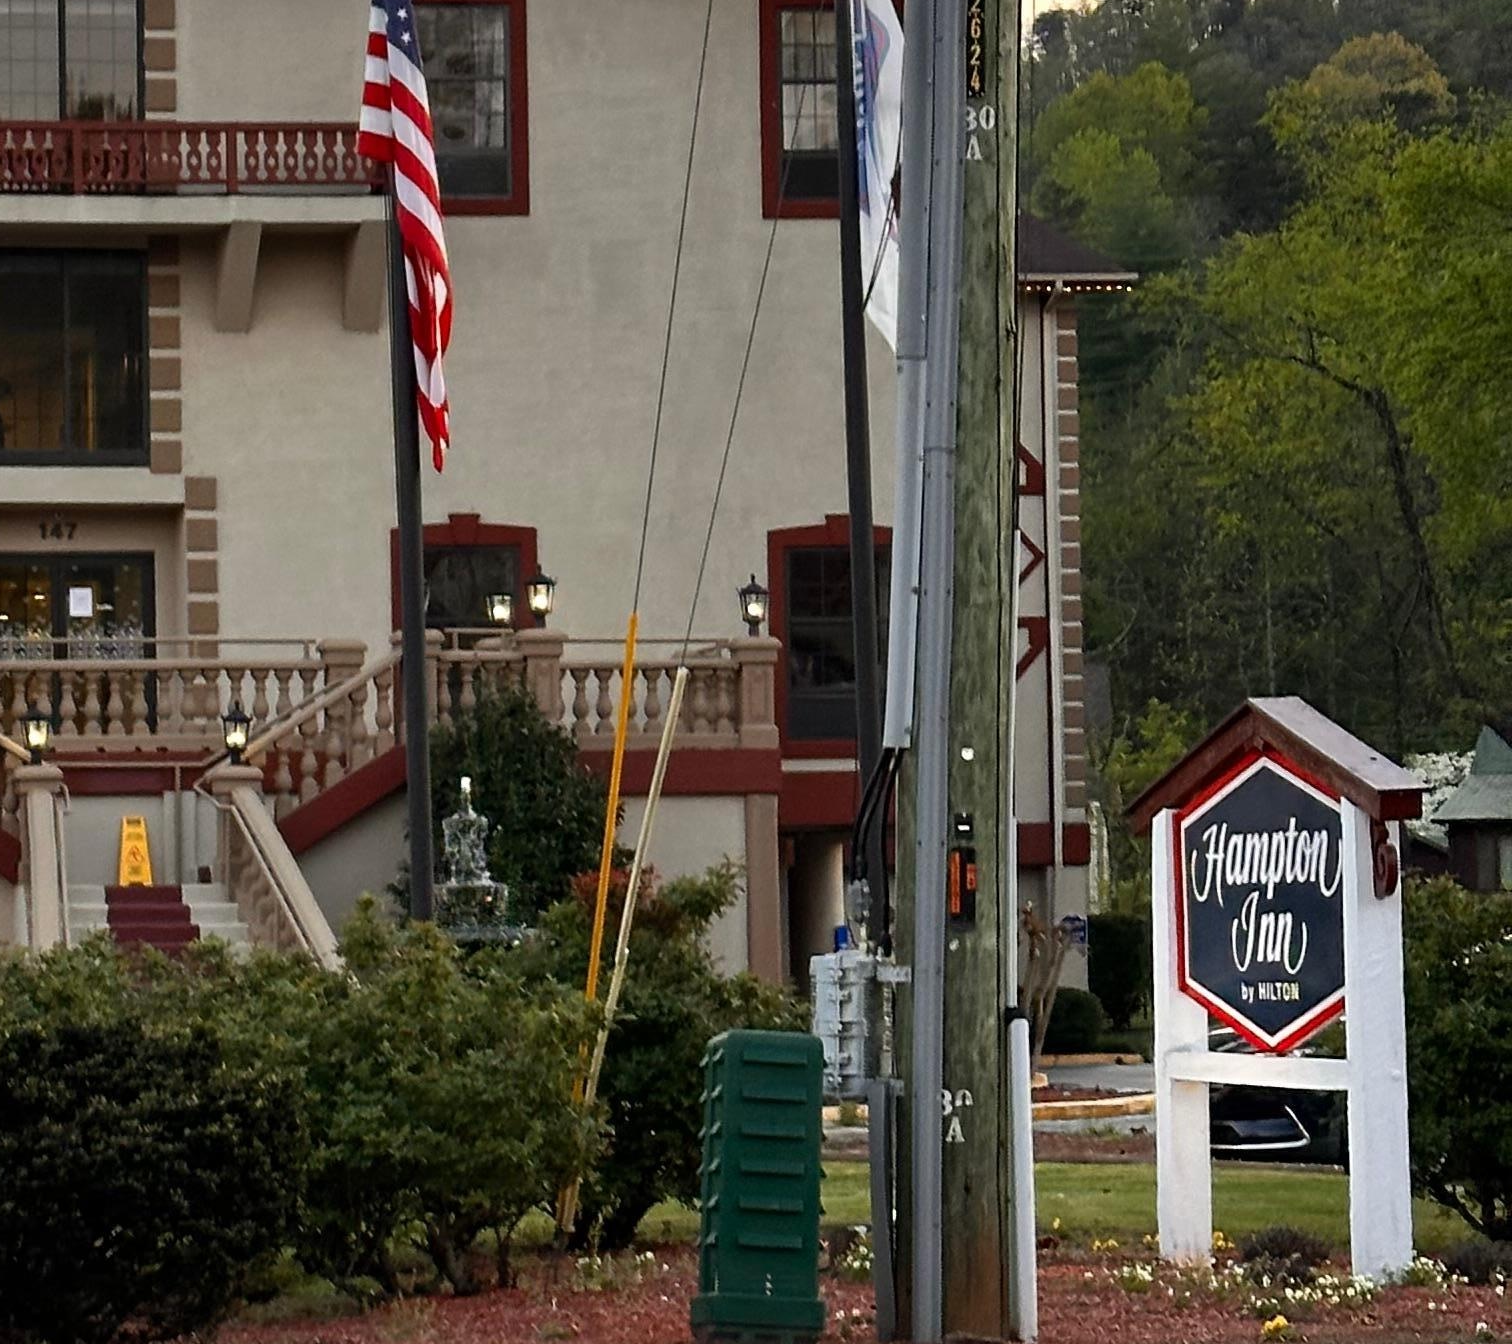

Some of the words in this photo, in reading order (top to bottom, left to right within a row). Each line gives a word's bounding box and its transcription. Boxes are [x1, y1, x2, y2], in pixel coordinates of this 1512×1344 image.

[966, 134, 983, 161] A
[39, 522, 77, 540] 147
[1191, 817, 1343, 909] Hampton
[1232, 891, 1307, 975] Inn
[1241, 982, 1254, 1003] by
[1258, 982, 1300, 1001] HILTON
[945, 1116, 966, 1143] A
